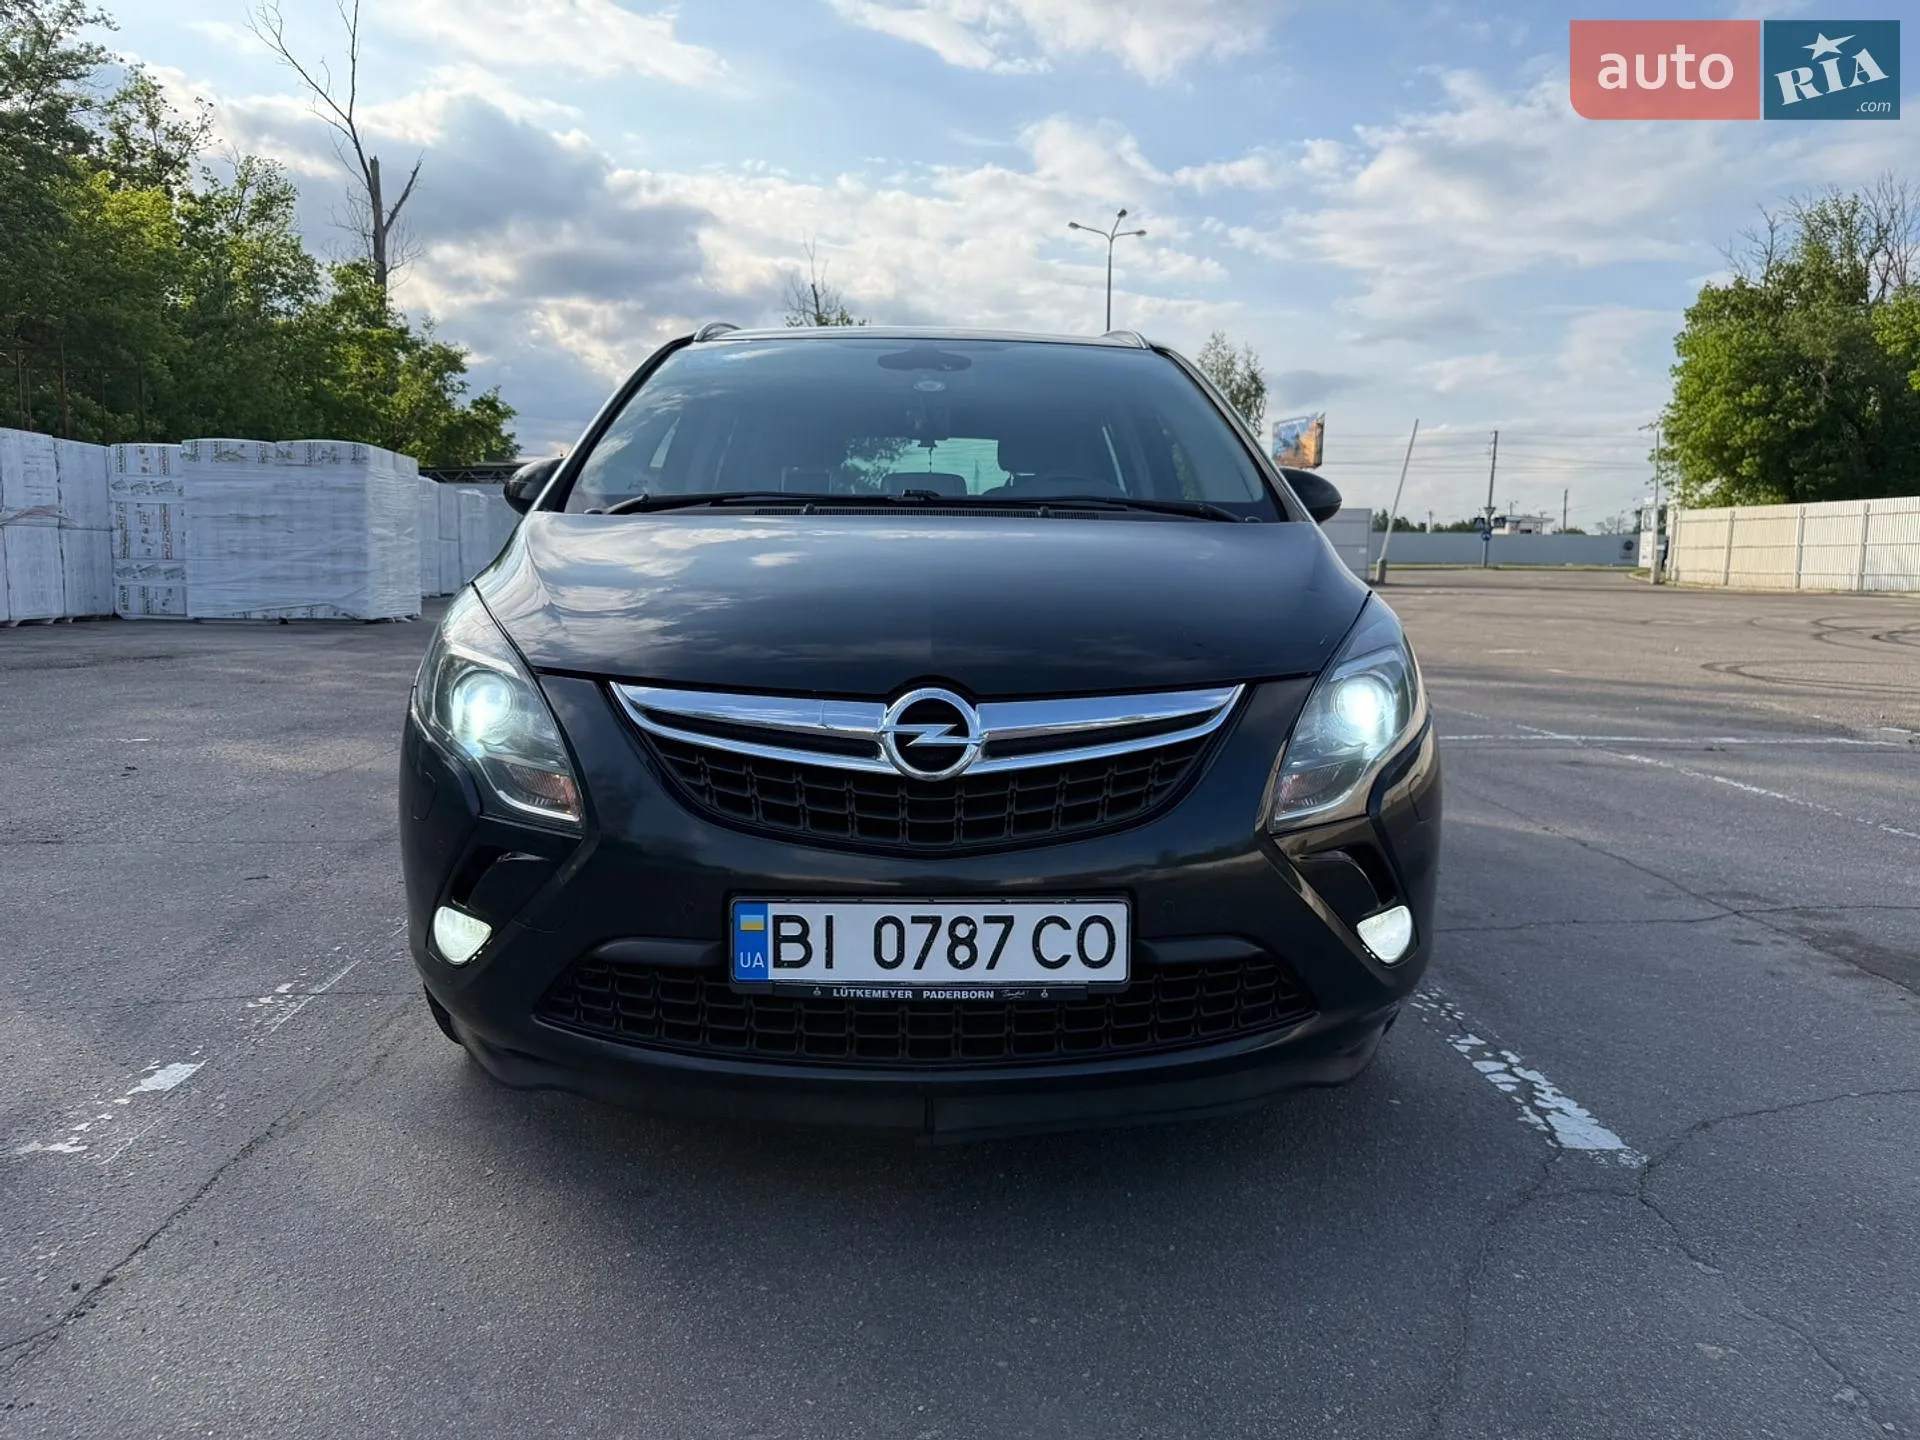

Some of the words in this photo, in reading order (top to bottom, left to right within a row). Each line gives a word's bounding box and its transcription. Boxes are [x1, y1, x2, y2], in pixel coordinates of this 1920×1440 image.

[772, 915, 834, 969] BI
[874, 915, 1015, 970] 0787
[1032, 915, 1116, 970] CO
[740, 951, 765, 969] UA
[833, 987, 913, 999] LÜTKEMEYER
[923, 990, 994, 999] PADERBORN
